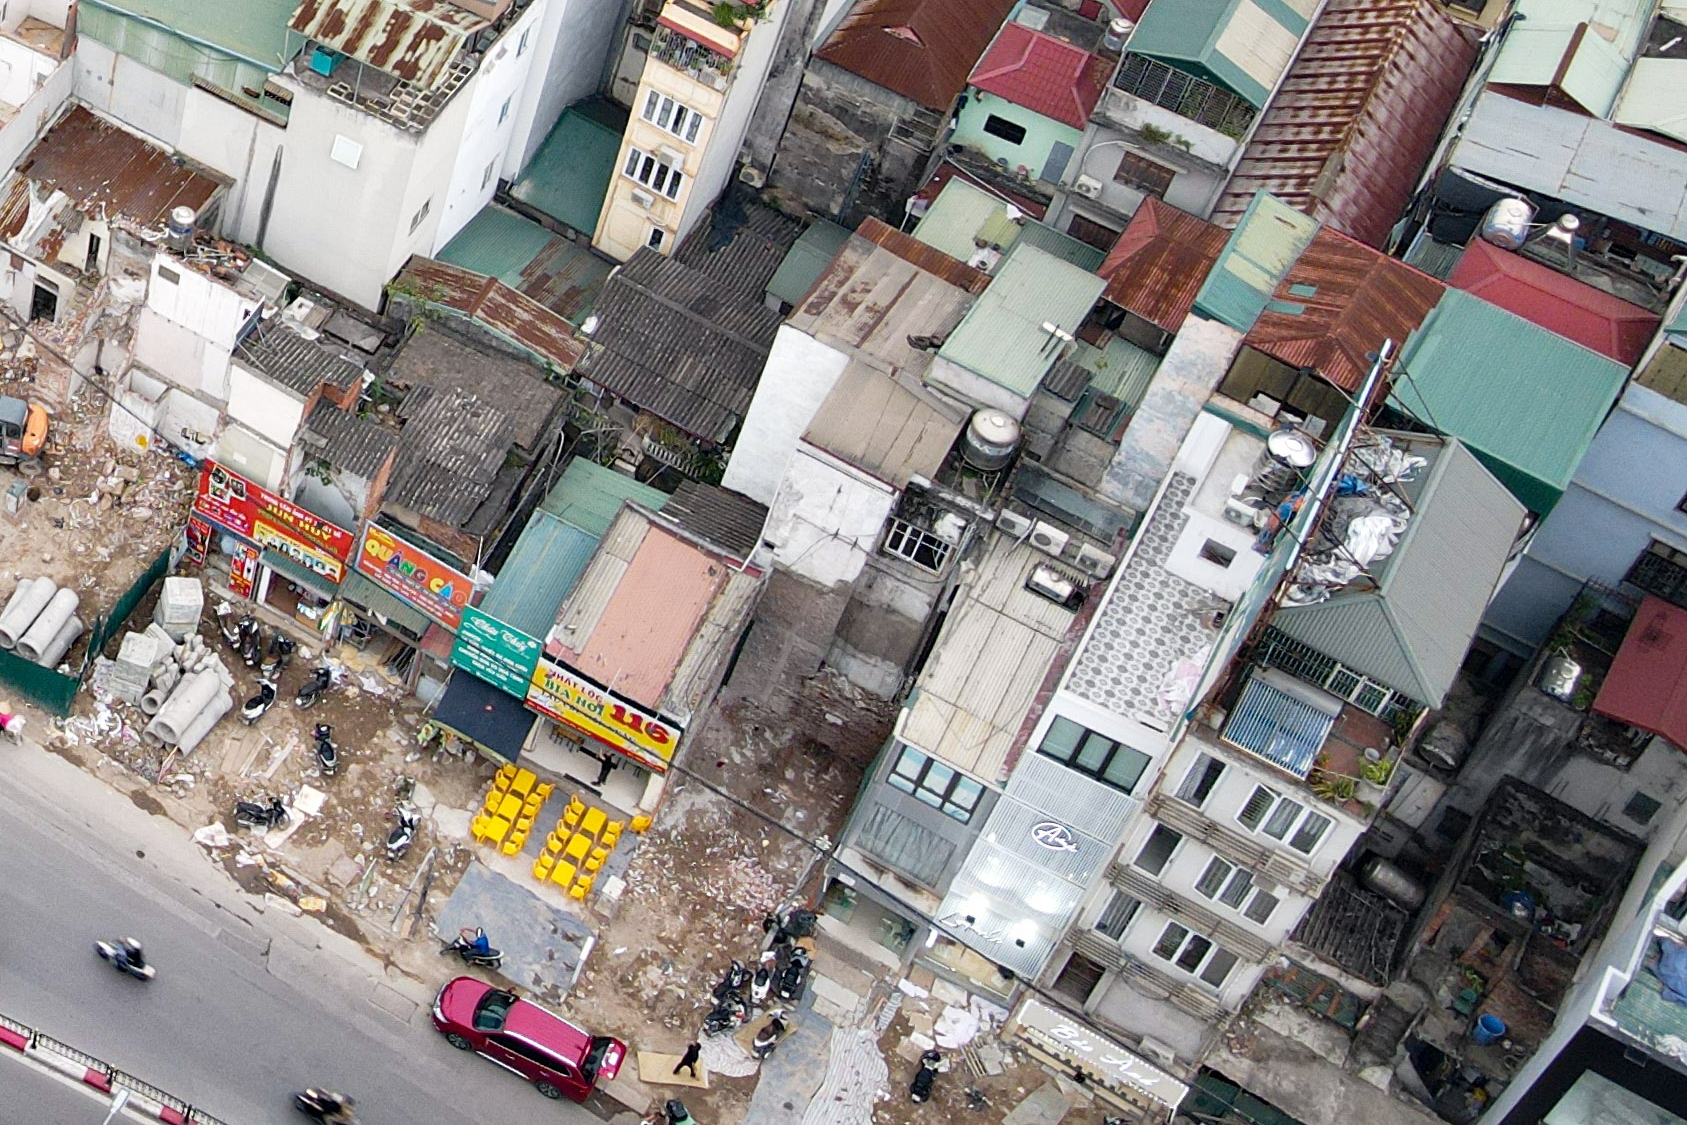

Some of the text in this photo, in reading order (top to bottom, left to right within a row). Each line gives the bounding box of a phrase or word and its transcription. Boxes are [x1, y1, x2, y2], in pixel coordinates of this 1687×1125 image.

[365, 538, 428, 583] QUẢNG
[429, 577, 468, 607] CÁO
[545, 679, 571, 700] BIA
[610, 703, 670, 745] 116
